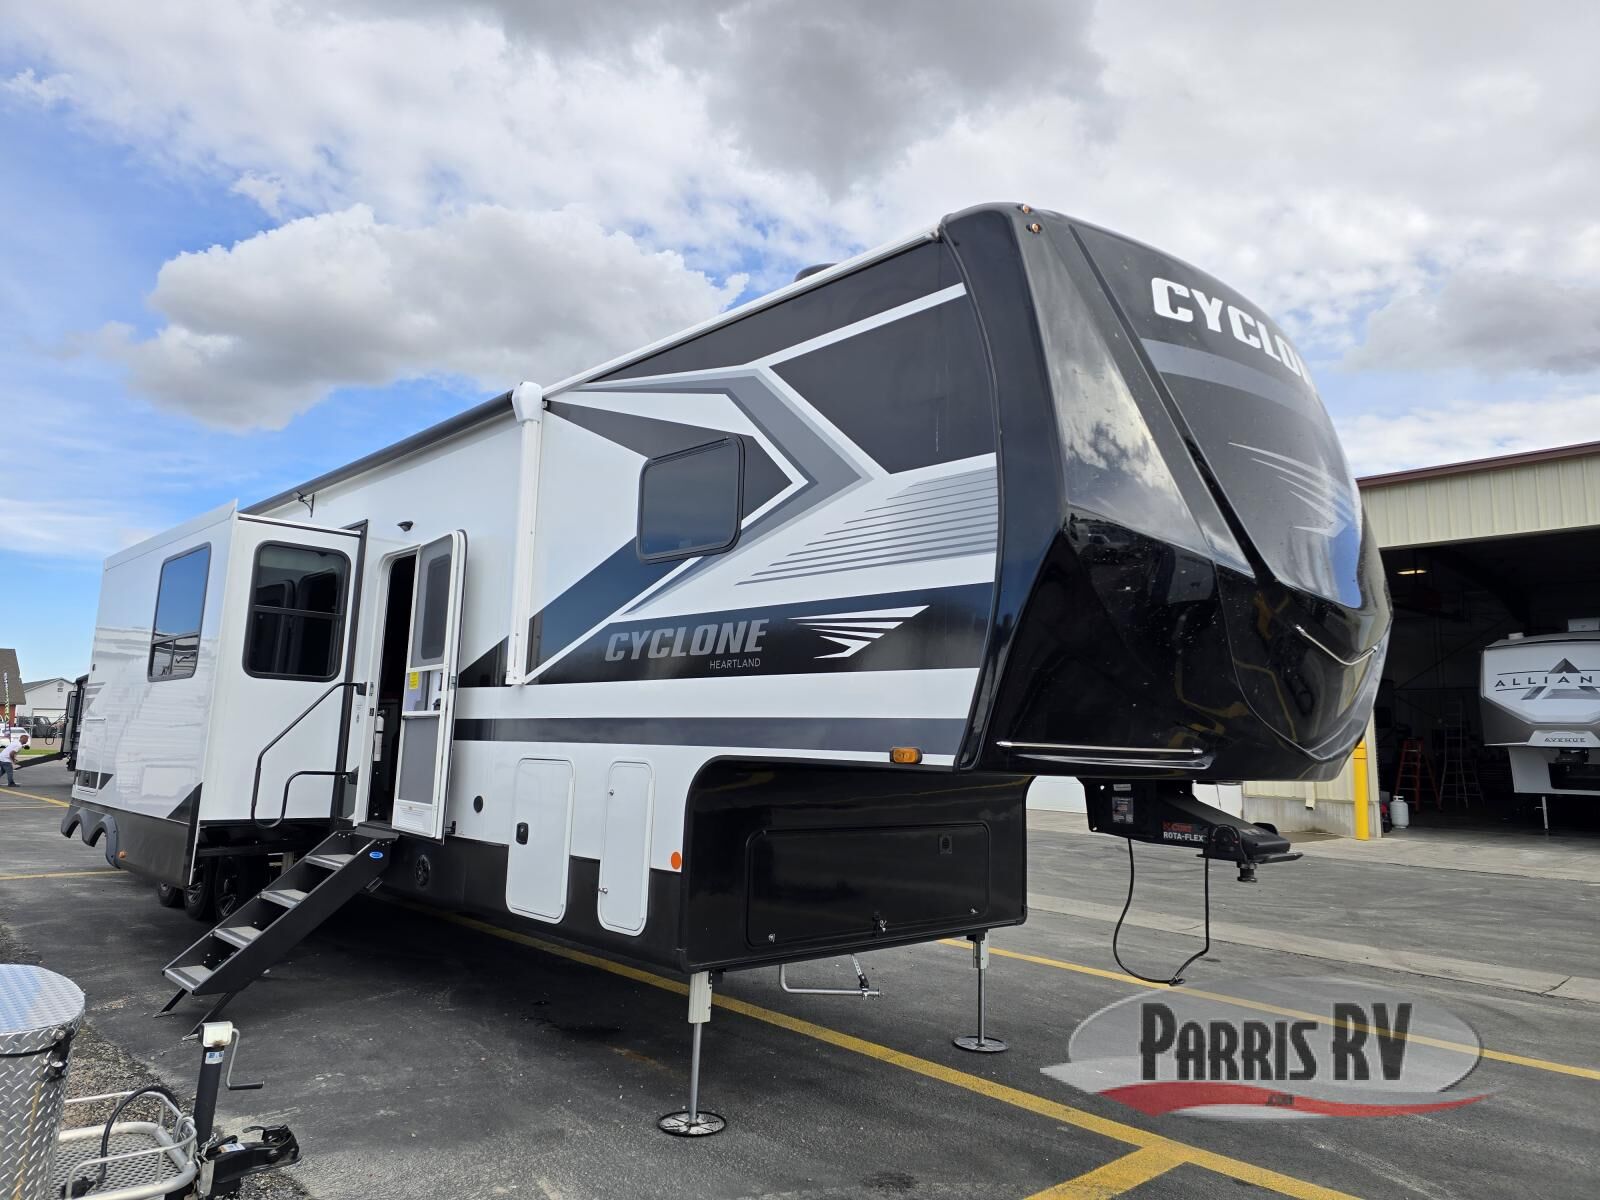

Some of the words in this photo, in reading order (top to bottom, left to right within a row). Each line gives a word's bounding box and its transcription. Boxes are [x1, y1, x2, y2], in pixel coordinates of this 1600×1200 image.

[604, 618, 769, 662] CYCLONE
[709, 657, 761, 670] HEARTLAND
[1494, 675, 1593, 687] ALLIAN
[1163, 831, 1204, 842] ROTA-FLEX
